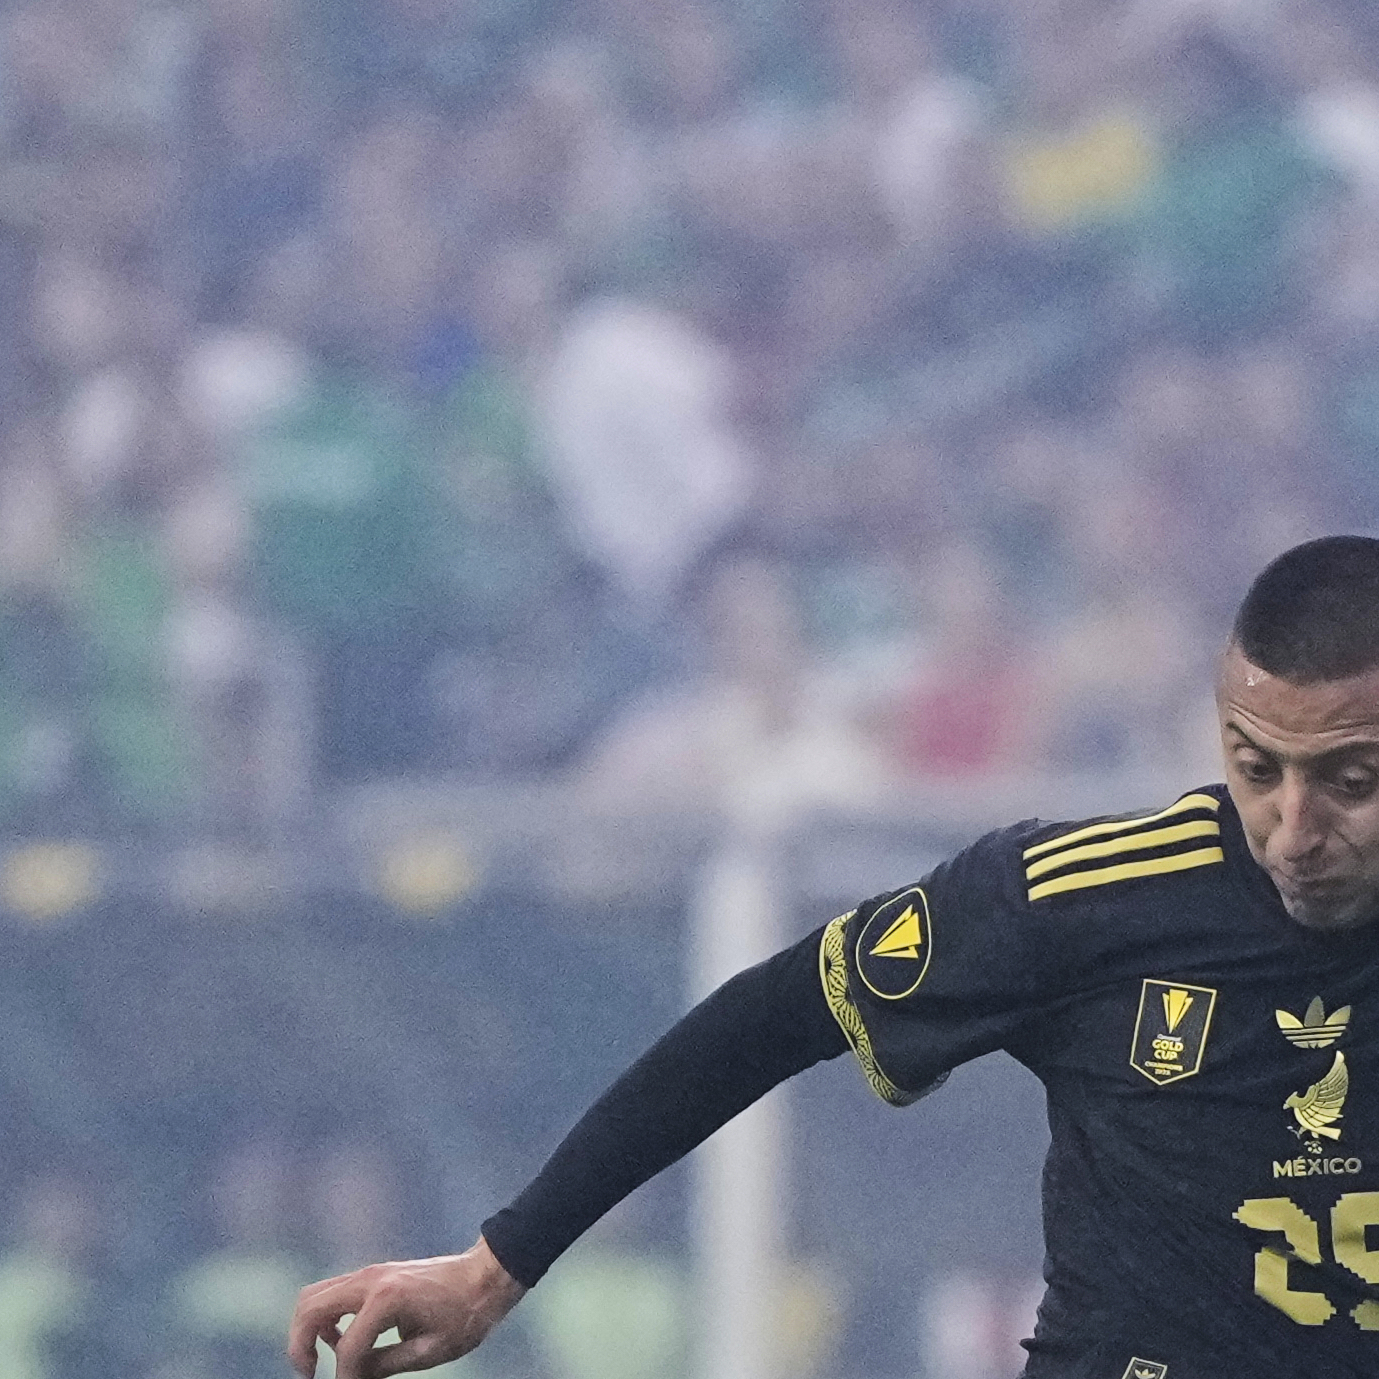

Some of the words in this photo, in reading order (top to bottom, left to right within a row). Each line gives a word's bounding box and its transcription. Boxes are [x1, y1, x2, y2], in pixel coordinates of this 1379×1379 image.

[1151, 1039, 1184, 1052] GOLD
[1153, 1049, 1178, 1061] CUP
[1272, 1155, 1362, 1179] MÉXICO
